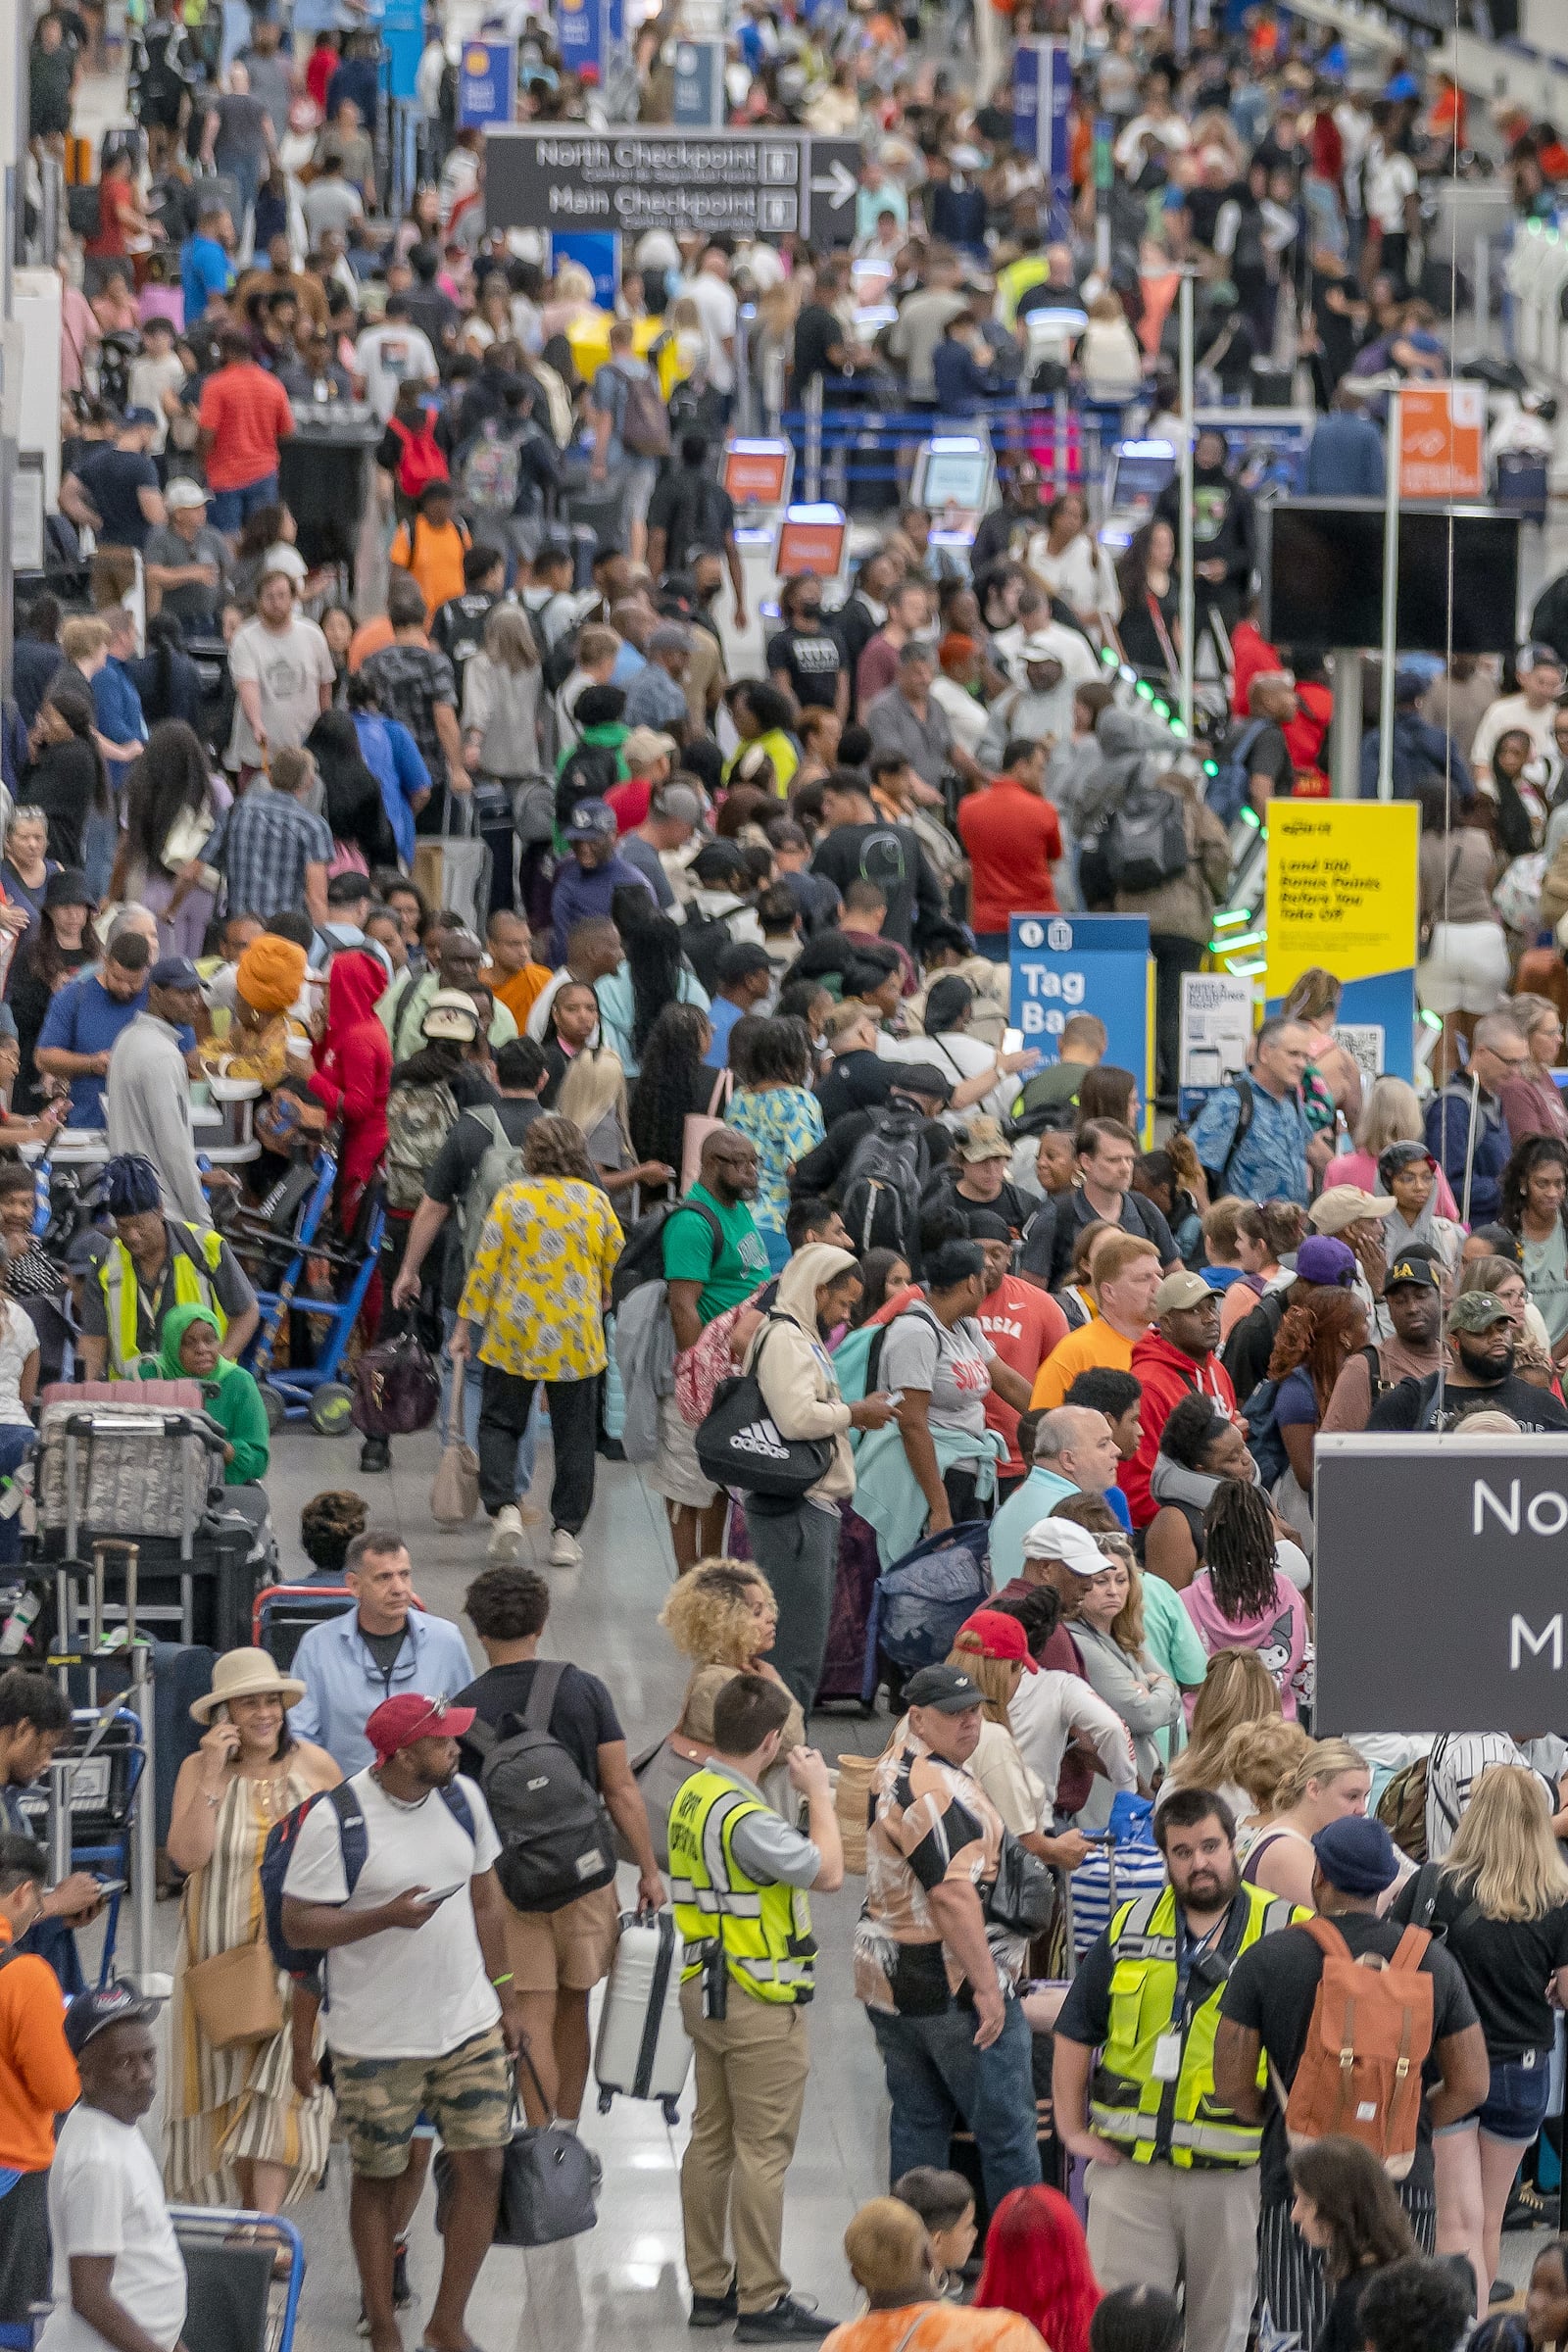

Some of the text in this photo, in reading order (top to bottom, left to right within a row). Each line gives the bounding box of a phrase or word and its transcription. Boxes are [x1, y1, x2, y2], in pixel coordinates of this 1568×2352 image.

[536, 139, 758, 171] North Checkpoint
[549, 185, 758, 217] Main Checkpoint
[1020, 963, 1085, 1005] Tag
[1021, 1001, 1092, 1035] Ba
[729, 1435, 791, 1459] adidas
